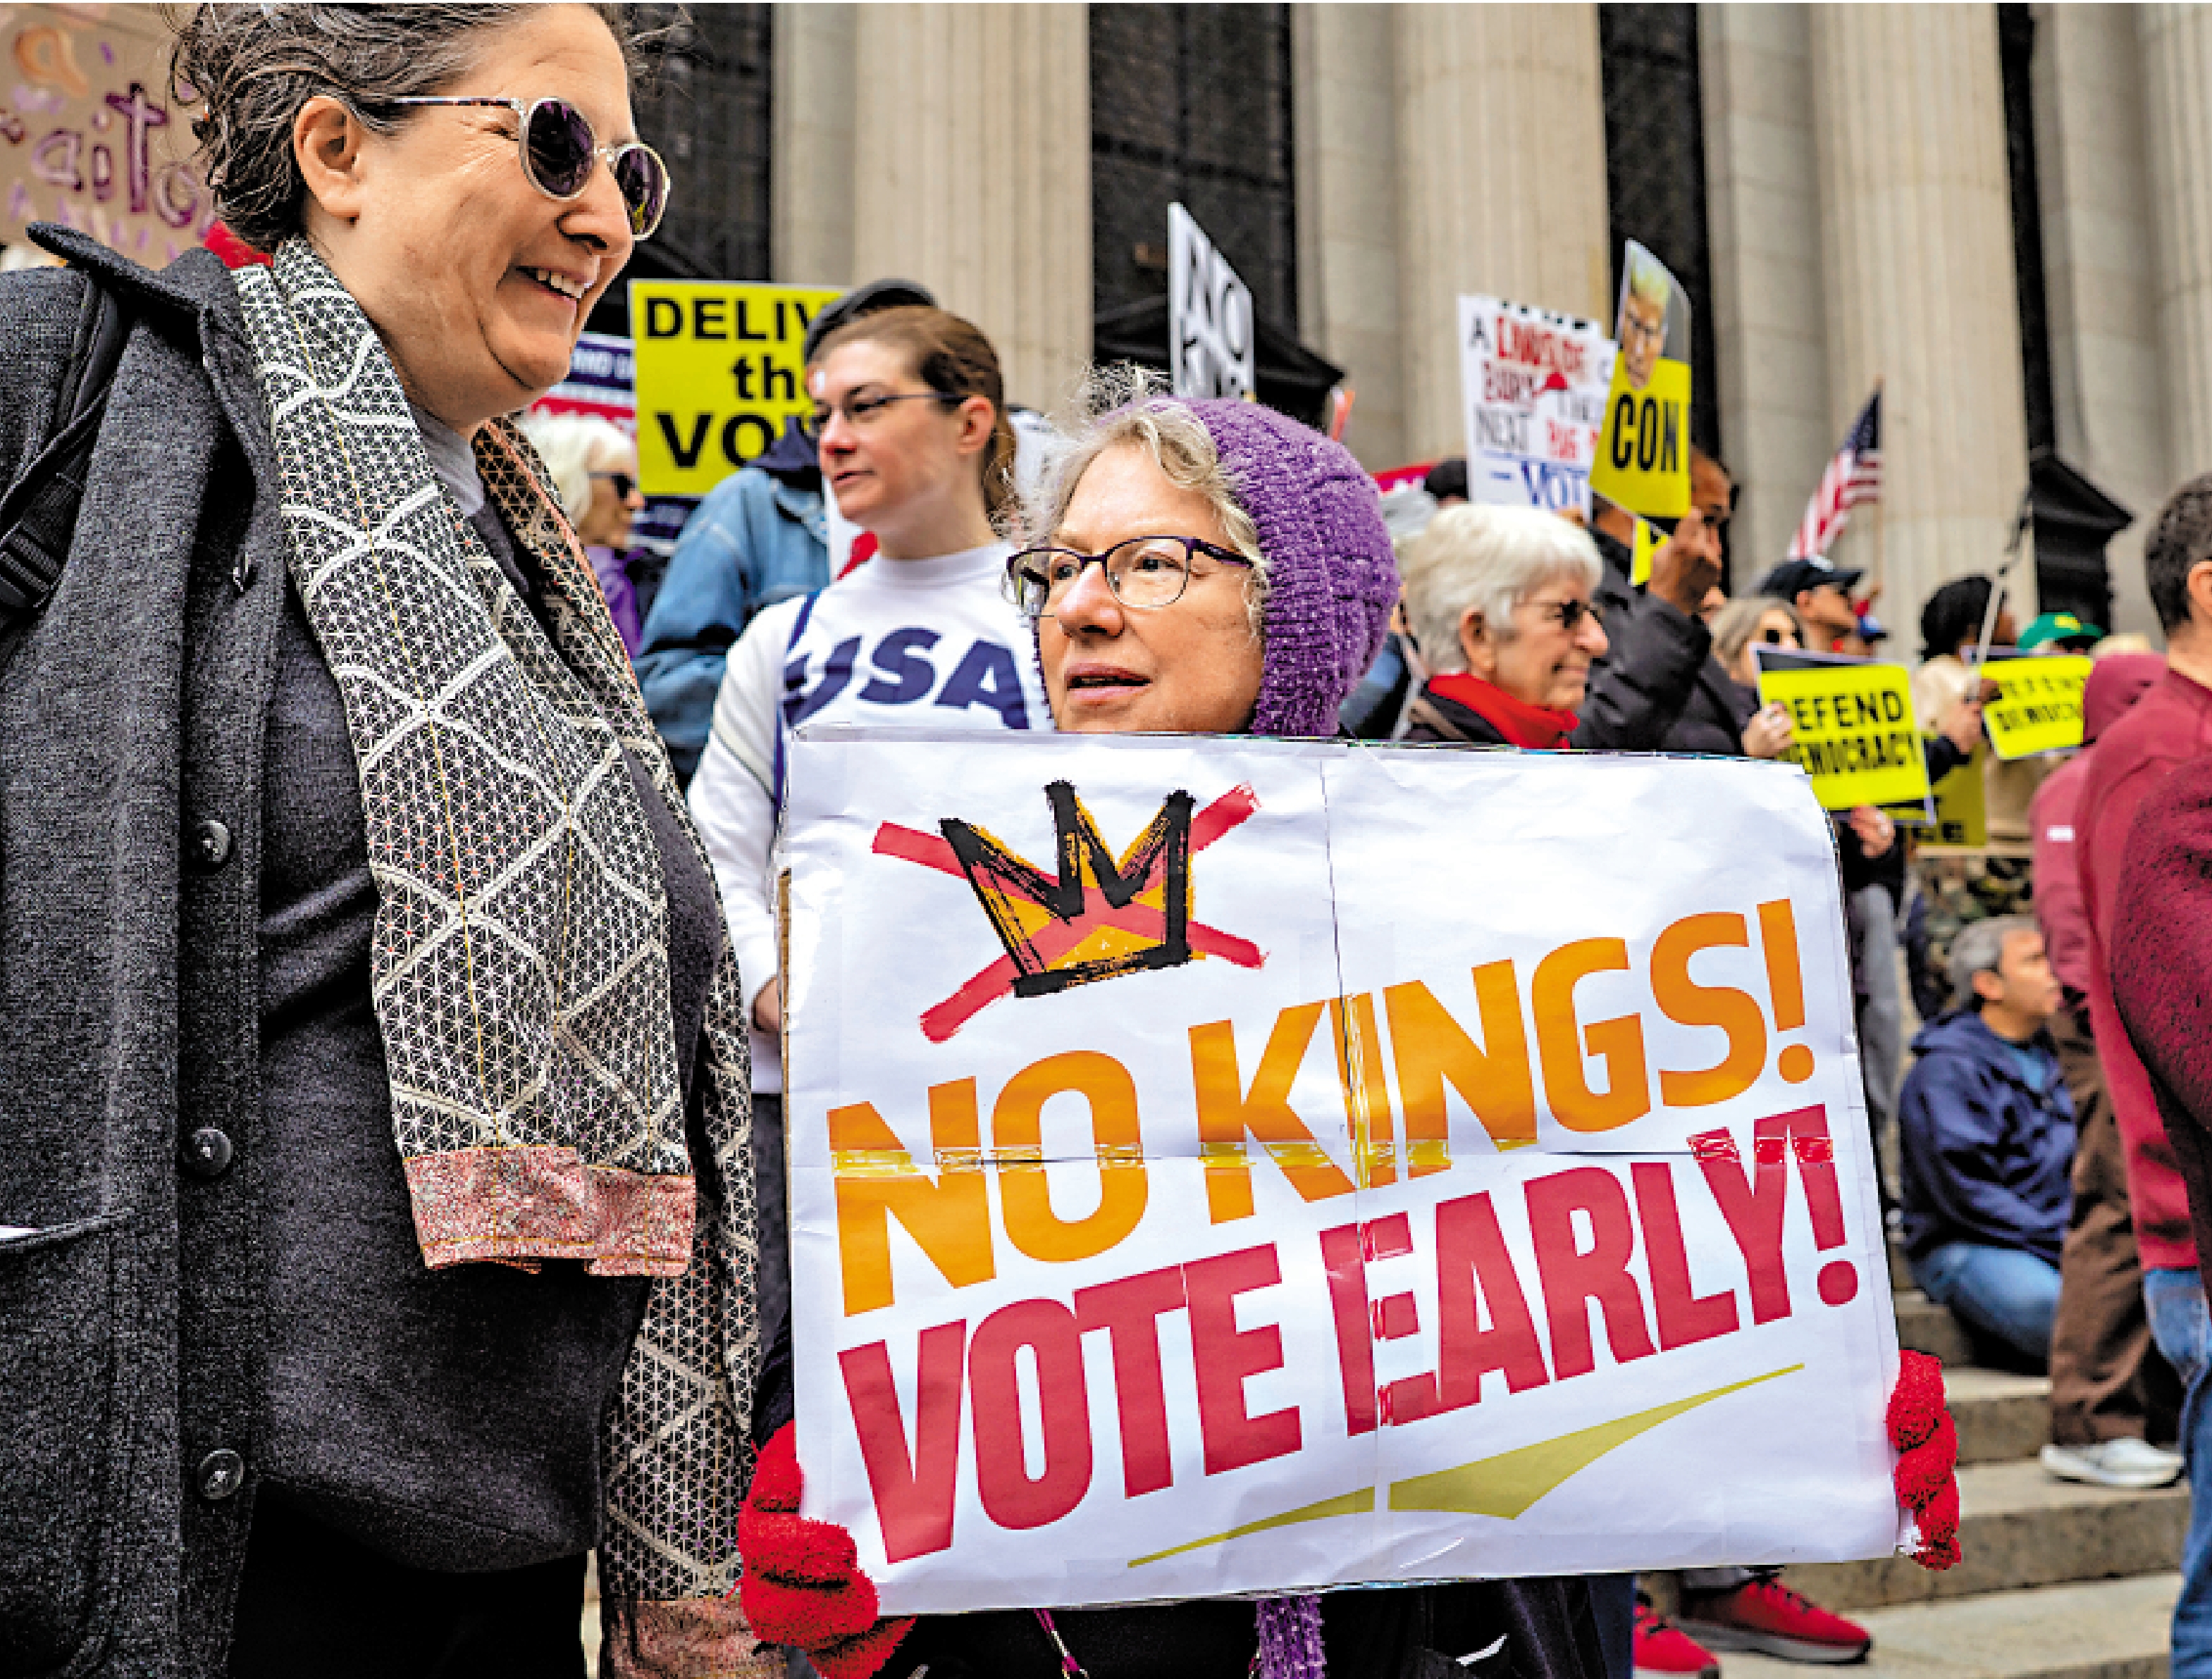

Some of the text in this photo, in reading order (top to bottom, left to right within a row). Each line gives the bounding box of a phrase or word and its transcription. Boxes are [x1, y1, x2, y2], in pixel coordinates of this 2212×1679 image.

[0, 80, 200, 228] aito
[1468, 312, 1490, 349] A
[729, 354, 796, 400] th
[655, 410, 777, 471] VO
[1611, 393, 1679, 473] CON
[1519, 458, 1589, 510] VOT
[783, 627, 1030, 730] USA
[1792, 688, 1904, 733] EFEND
[1779, 729, 1920, 775] EMOCRACY
[827, 898, 1815, 1318] NO KINGS!
[837, 1103, 1859, 1565] VOTE EARLY!
